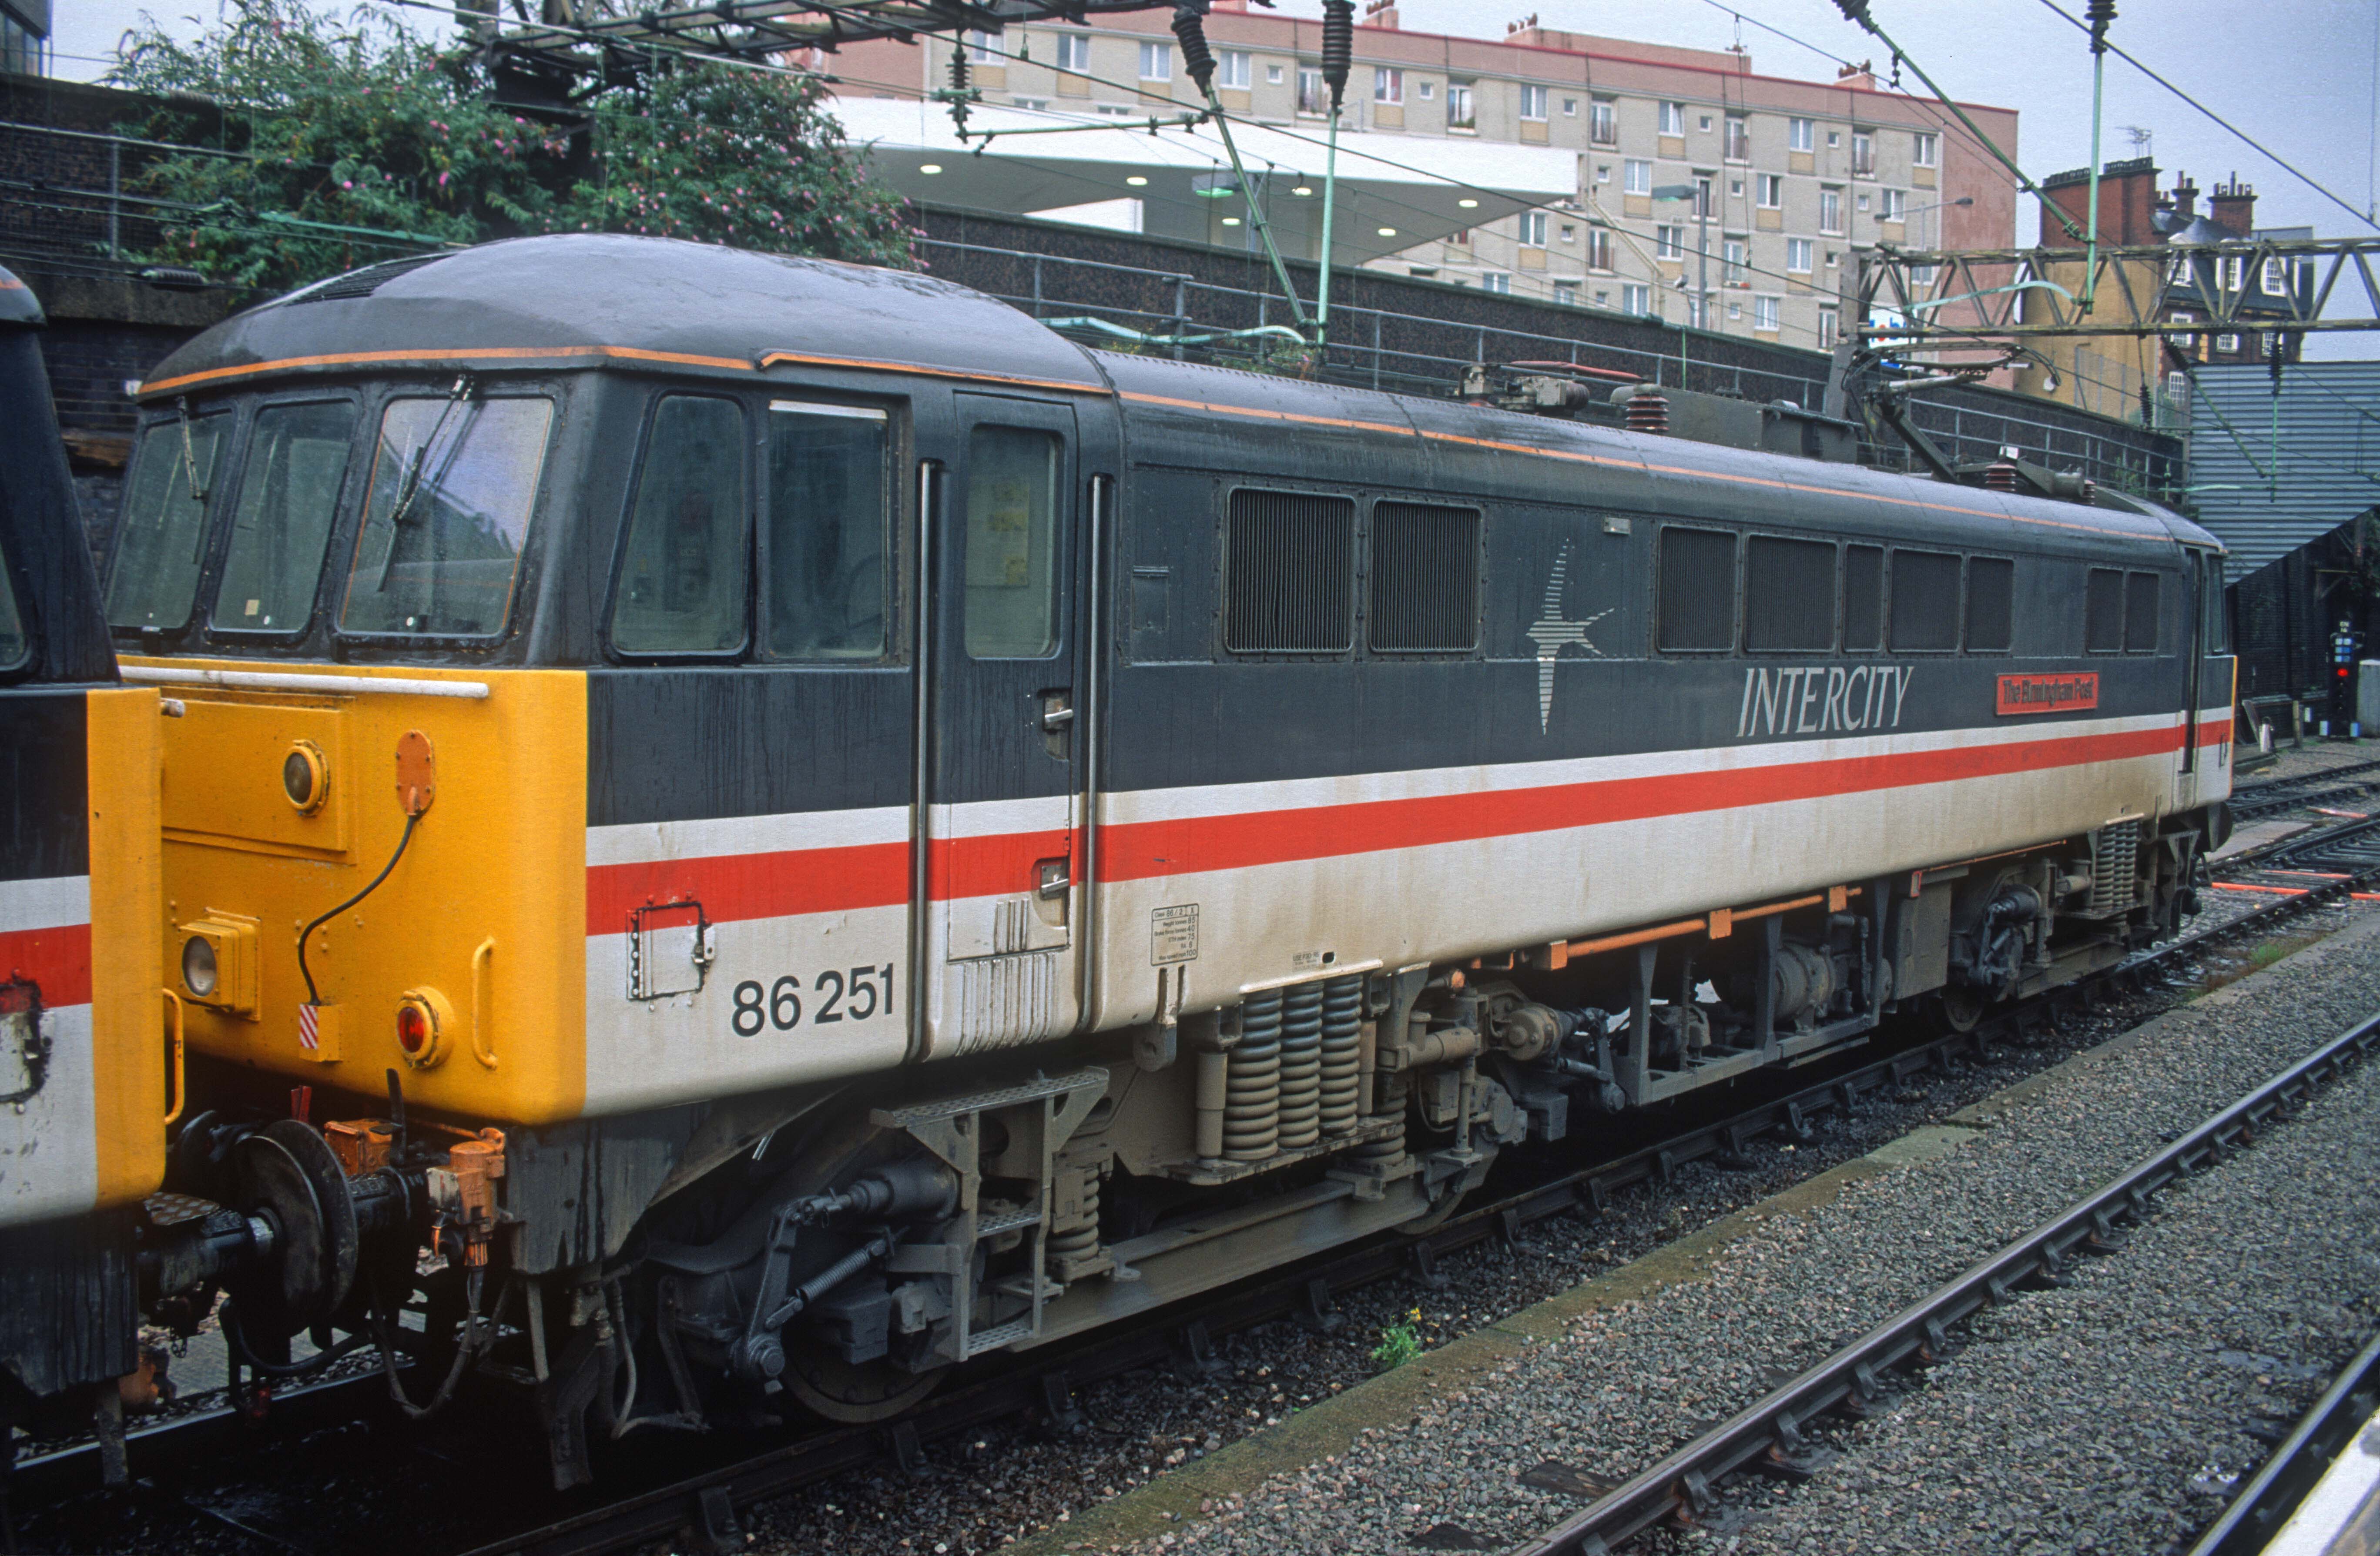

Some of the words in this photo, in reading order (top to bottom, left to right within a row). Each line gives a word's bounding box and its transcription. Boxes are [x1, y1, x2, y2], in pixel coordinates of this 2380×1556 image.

[1736, 665, 1914, 737] INTERCITY
[2003, 679, 2020, 703] The
[2022, 677, 2073, 706] Birmingham
[2075, 677, 2094, 699] Post
[731, 975, 801, 1037] 86
[815, 963, 893, 1024] 251
